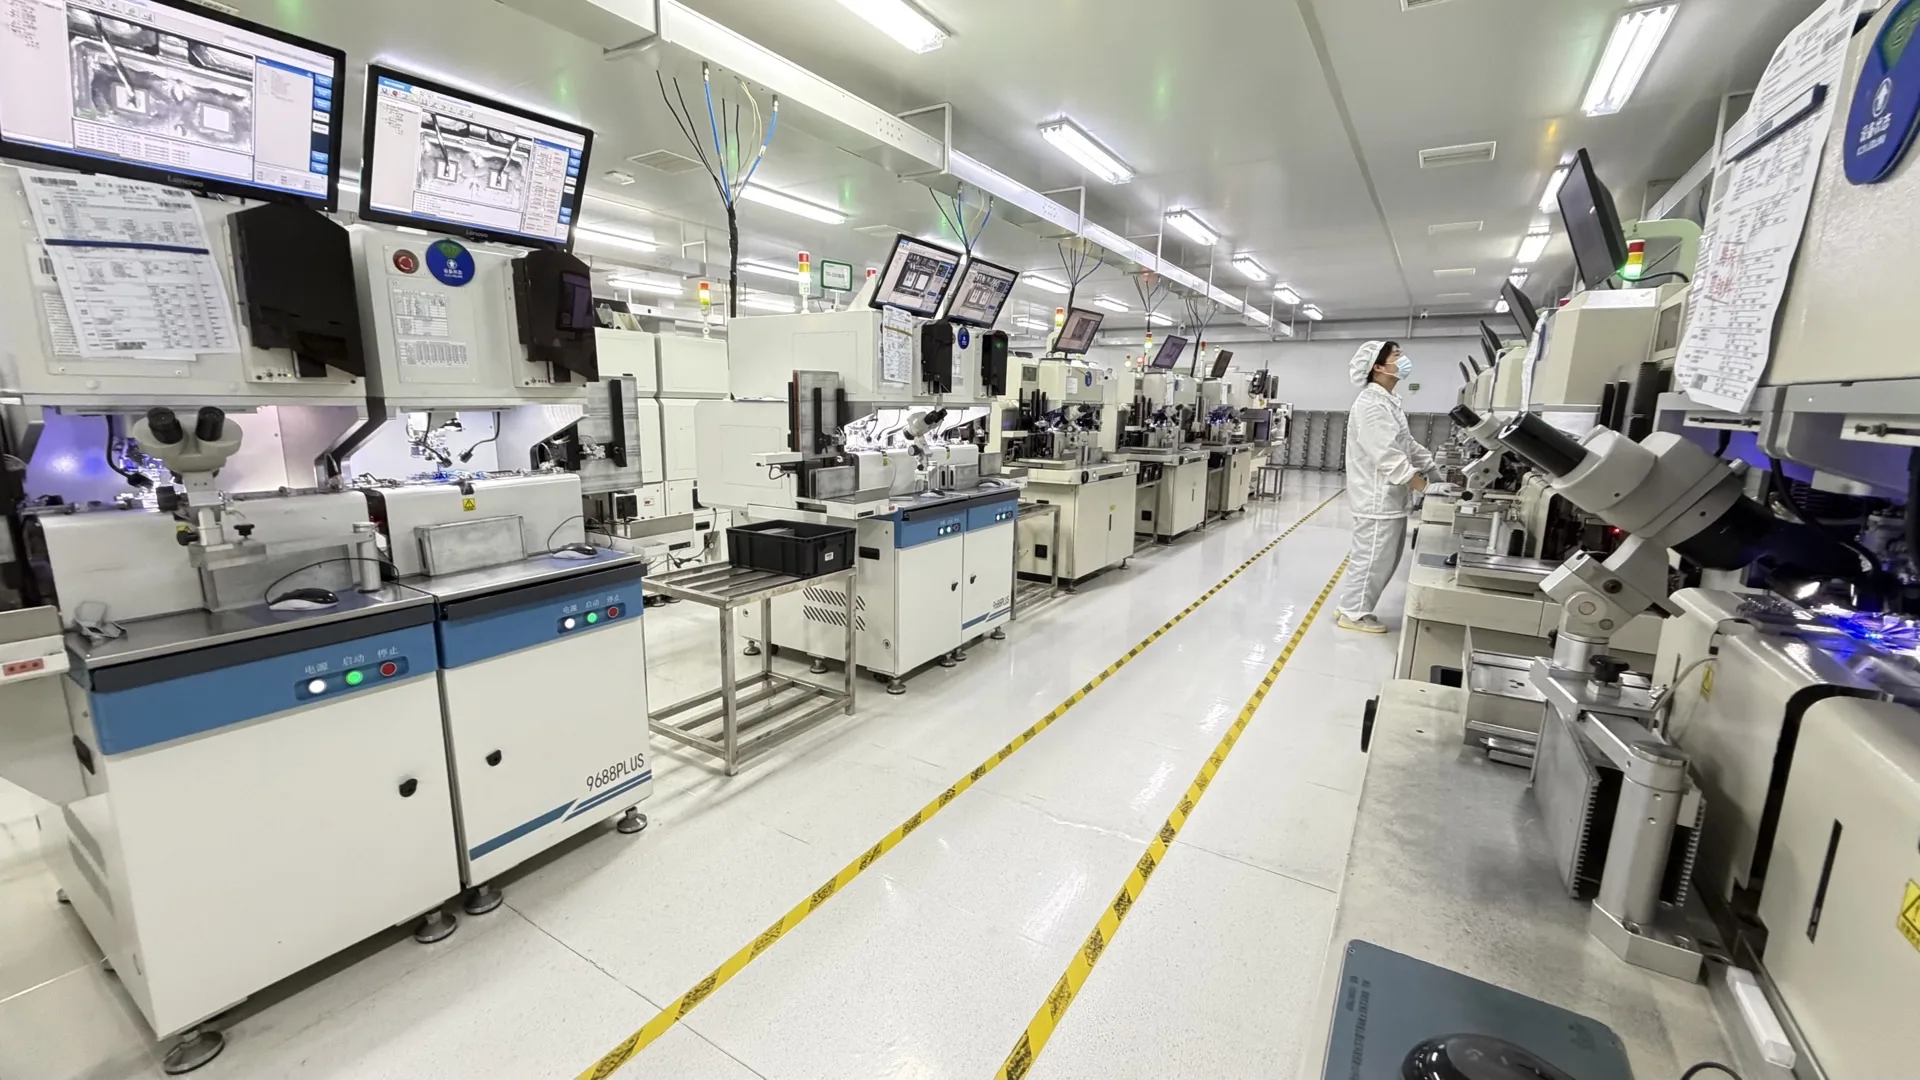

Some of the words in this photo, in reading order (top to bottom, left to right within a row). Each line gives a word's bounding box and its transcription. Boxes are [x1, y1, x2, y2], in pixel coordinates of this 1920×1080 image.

[167, 174, 204, 188] Lenovo
[465, 229, 489, 238] Lenovo
[585, 599, 600, 608] 启动
[606, 594, 621, 604] 停止
[304, 661, 329, 675] 电源
[341, 653, 365, 667] 启动
[377, 646, 399, 658] 停止
[586, 752, 645, 792] 9688PLUS
